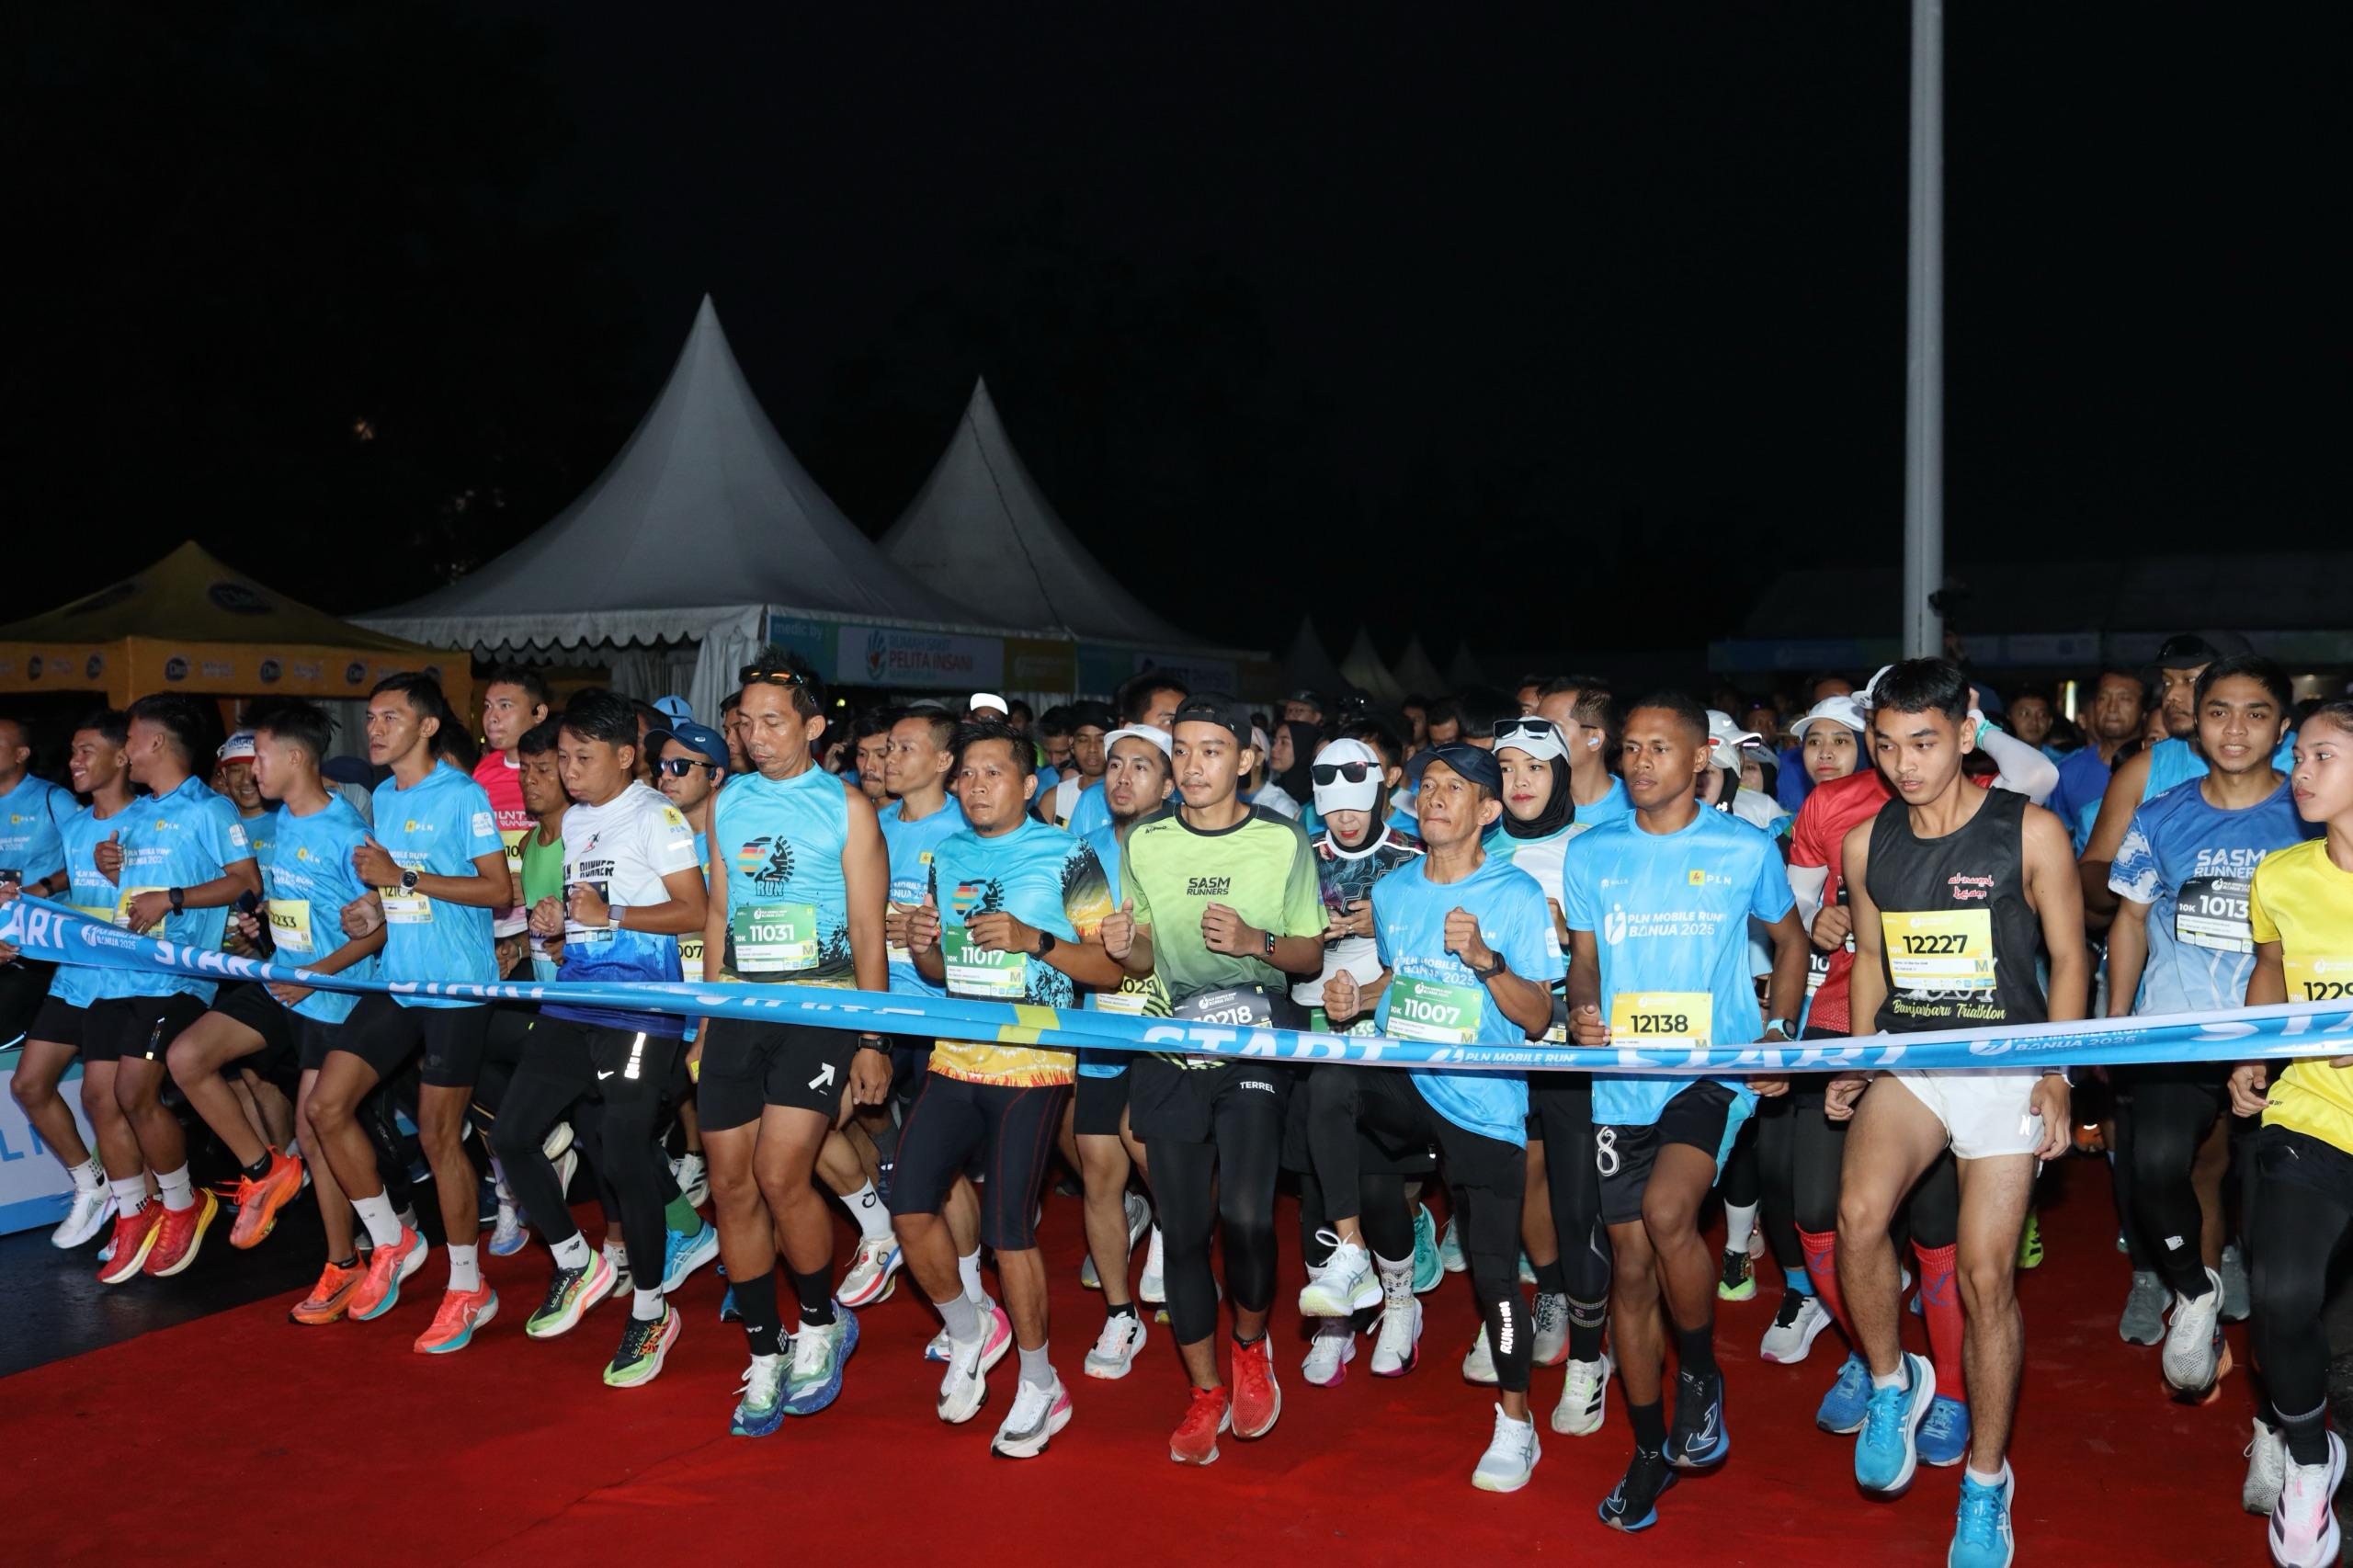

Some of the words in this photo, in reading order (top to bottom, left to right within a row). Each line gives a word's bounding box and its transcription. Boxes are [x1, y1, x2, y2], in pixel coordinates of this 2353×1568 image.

[890, 651, 927, 669] PELITA
[415, 824, 433, 832] PLN
[2196, 848, 2267, 867] SASM
[1706, 874, 1732, 884] PLN
[2194, 866, 2256, 879] RUNNER
[756, 881, 784, 896] RUN
[1188, 877, 1231, 888] SASM
[2179, 903, 2196, 913] 10K
[1628, 914, 1648, 925] PLN
[1653, 912, 1696, 923] MOBILE
[1699, 912, 1722, 923] RUN
[749, 925, 794, 942] 11031
[1629, 925, 1678, 937] BANUA
[1681, 924, 1715, 937] 2025
[119, 939, 136, 950] 2025
[802, 945, 813, 956] M
[1903, 935, 1968, 954] 12227
[961, 946, 1005, 966] 11017
[1974, 960, 1989, 972] M
[1011, 971, 1021, 983] M
[1442, 972, 1474, 986] 2025
[1193, 1006, 1253, 1025] 0218
[1391, 1006, 1402, 1015] 10K
[1404, 997, 1461, 1025] 11007
[1893, 999, 1951, 1017] Banjarbaru
[1956, 1003, 2006, 1019] Triathlon
[1631, 1015, 1688, 1033] 12138
[1461, 1032, 1475, 1044] M
[1695, 1039, 1708, 1049] M
[2015, 1040, 2083, 1051] BANUA
[2087, 1035, 2138, 1046] 2025
[1464, 1051, 1492, 1062] PLN
[1494, 1052, 1542, 1062] MOBILE
[1545, 1054, 1575, 1062] RUN
[1596, 1126, 1620, 1176] 8
